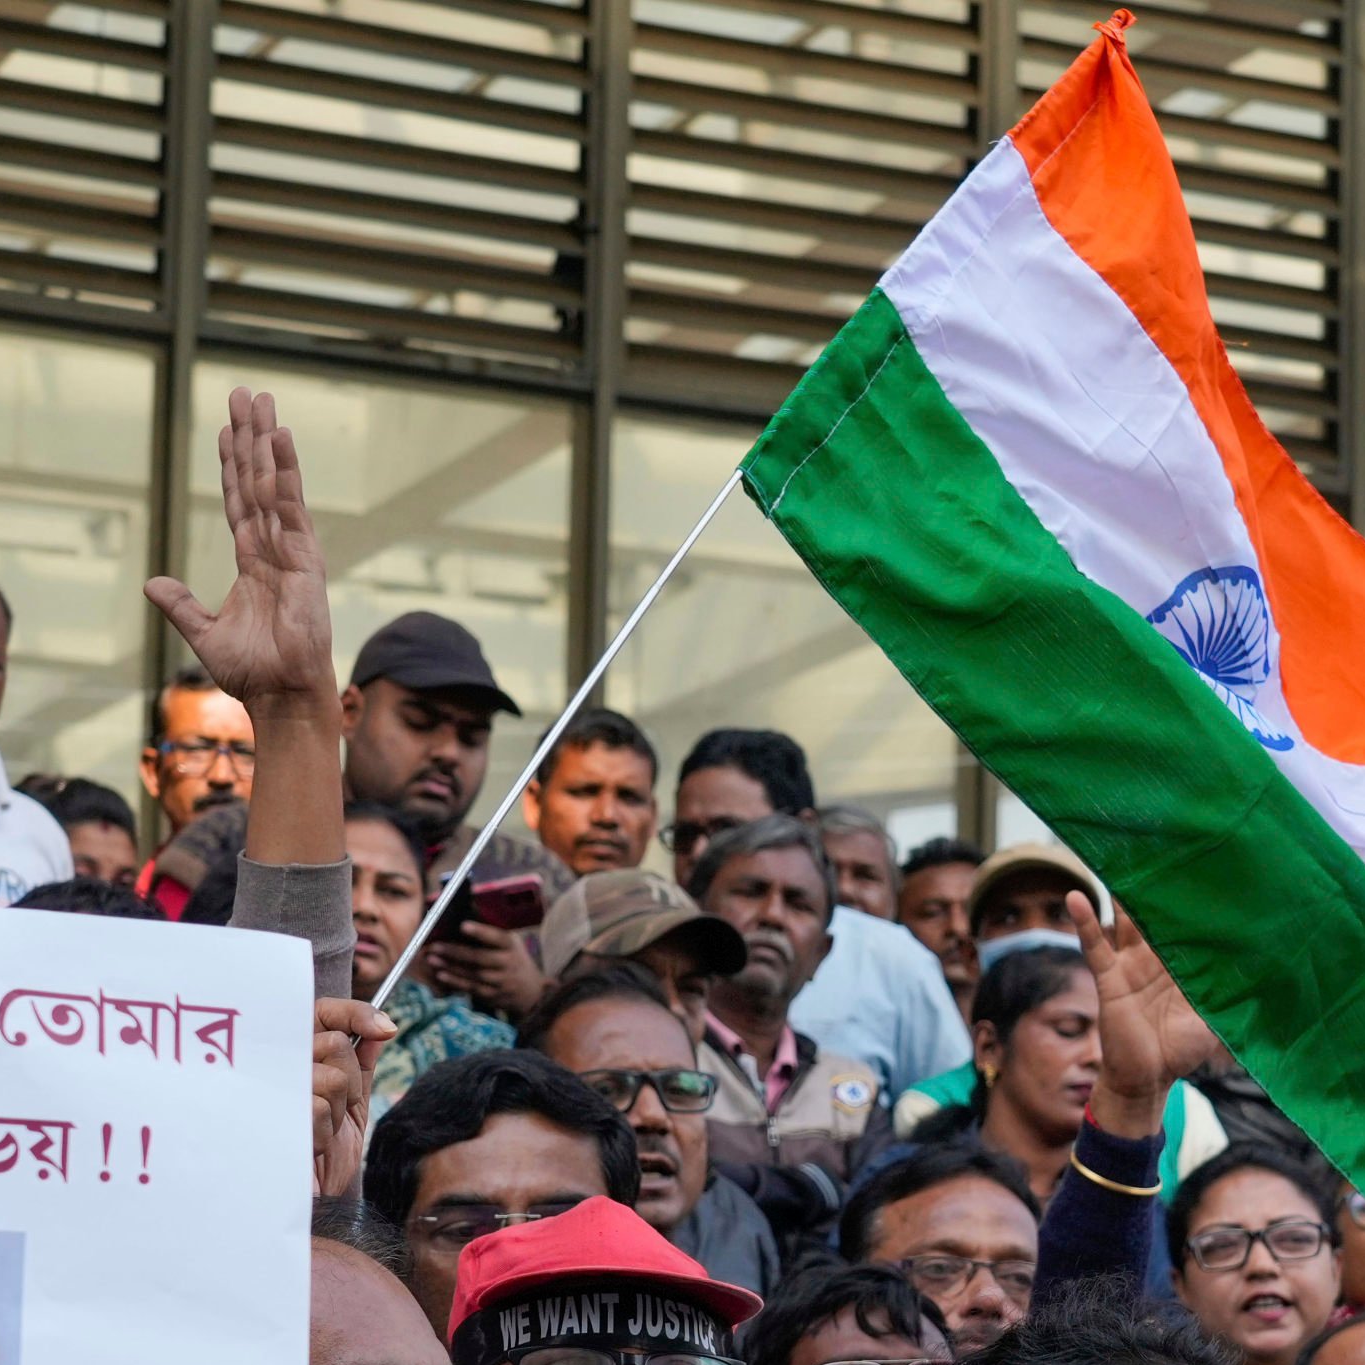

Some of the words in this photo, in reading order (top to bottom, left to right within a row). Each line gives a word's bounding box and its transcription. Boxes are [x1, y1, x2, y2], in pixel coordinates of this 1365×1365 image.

[499, 1302, 532, 1351] WE
[537, 1292, 621, 1339] WANT
[627, 1293, 717, 1355] JUSTICE
